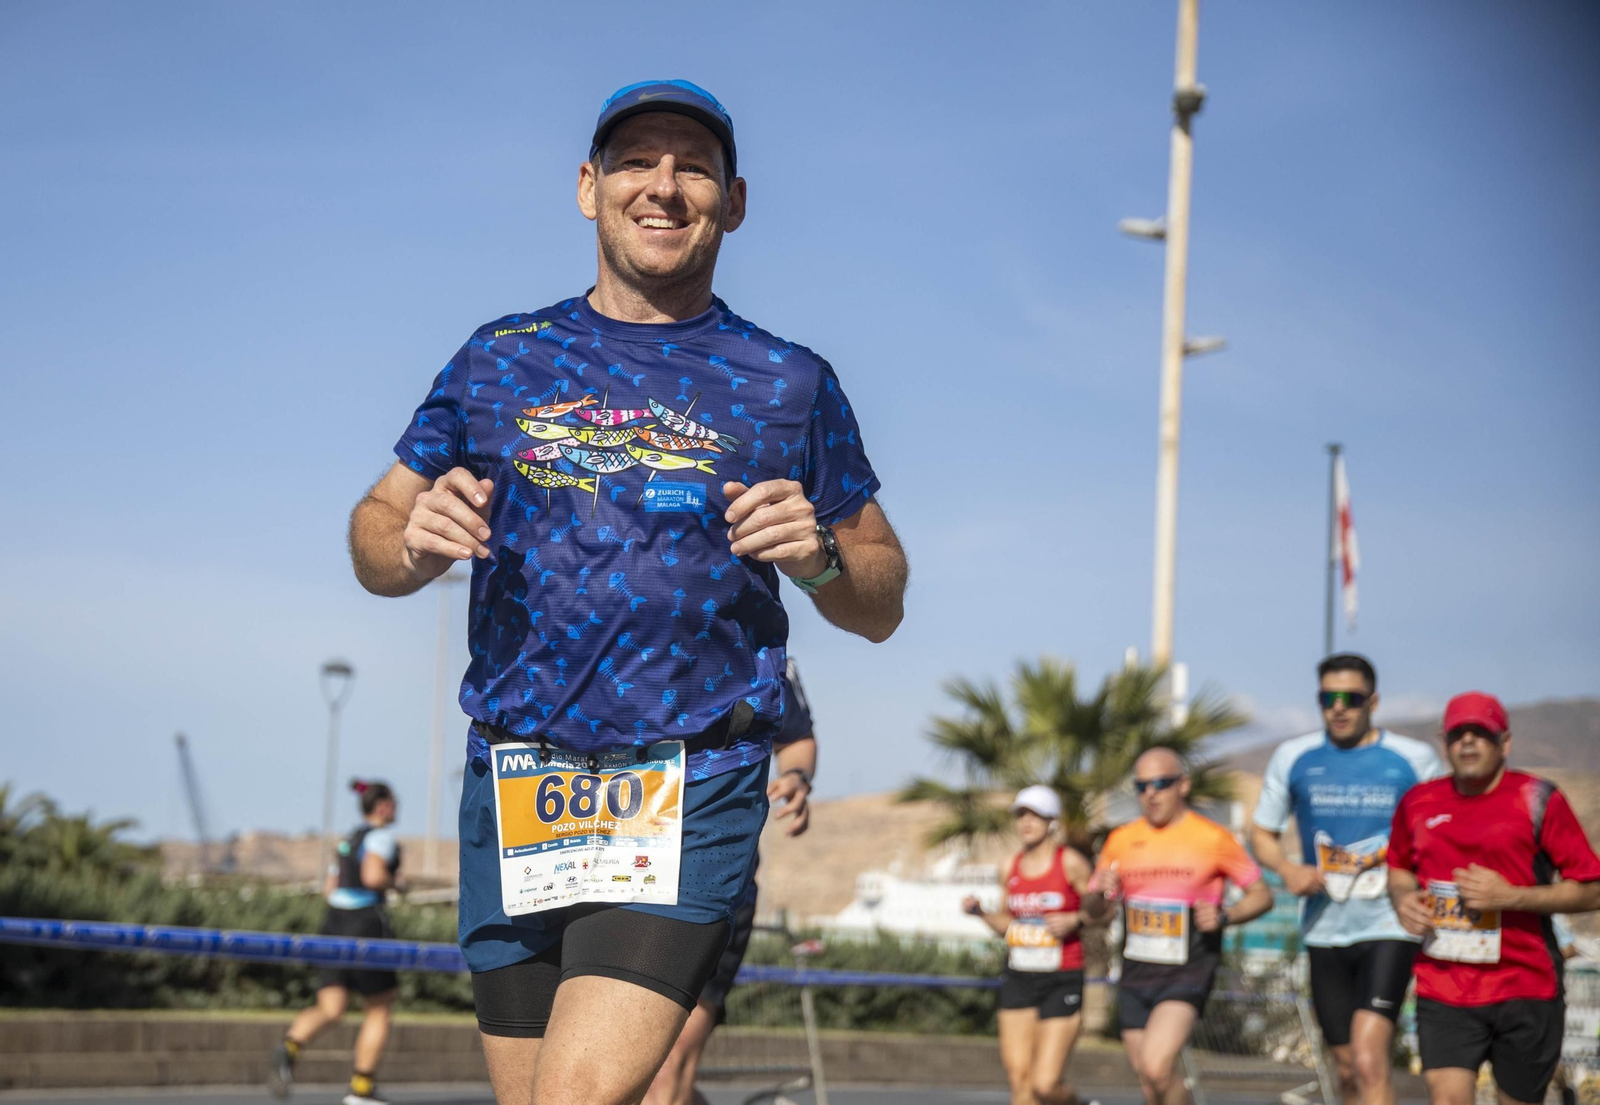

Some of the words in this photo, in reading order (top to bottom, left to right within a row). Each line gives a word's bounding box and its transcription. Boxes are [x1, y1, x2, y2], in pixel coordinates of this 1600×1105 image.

[535, 770, 644, 825] 680
[551, 822, 576, 834] POZO
[578, 820, 621, 830] VILCHEZ
[554, 860, 577, 874] NEXAL
